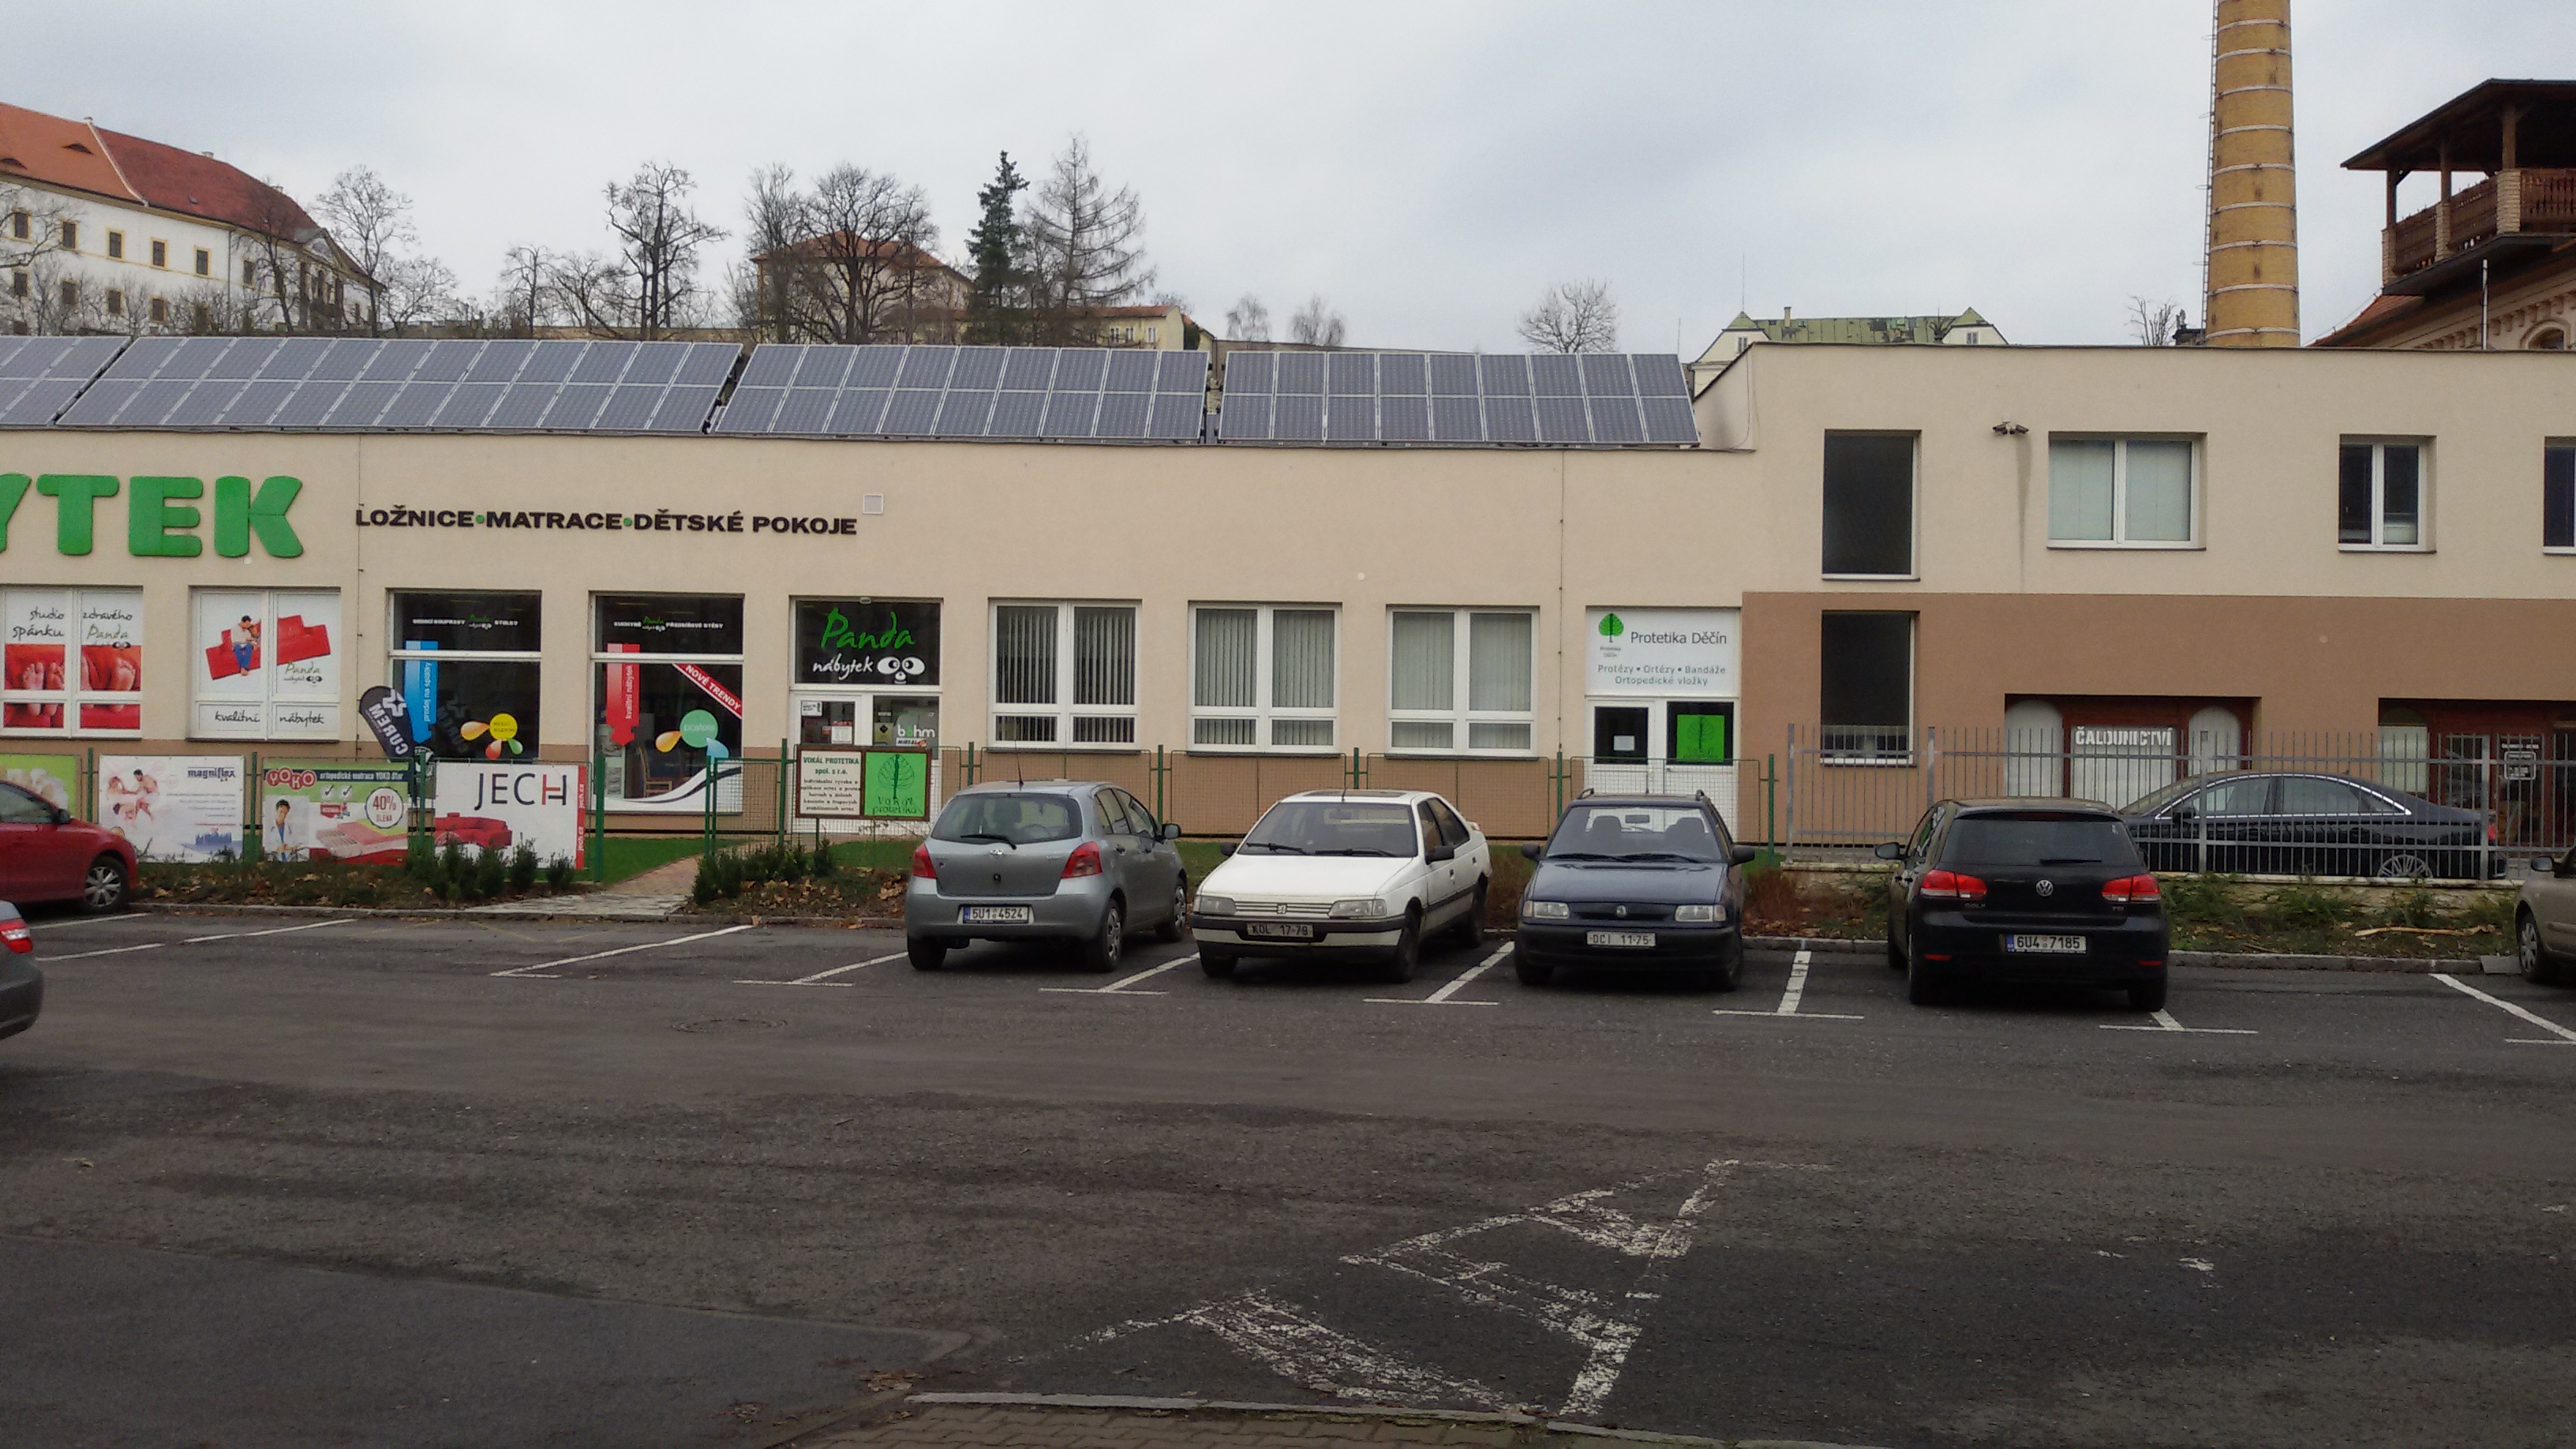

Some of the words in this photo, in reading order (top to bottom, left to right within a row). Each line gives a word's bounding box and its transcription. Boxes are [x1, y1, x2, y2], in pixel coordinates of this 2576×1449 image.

[356, 504, 474, 527] LOŽNICE
[486, 511, 622, 530] MATRACE
[634, 508, 743, 532] DĚTSKÉ
[752, 515, 857, 535] POKOJE
[30, 606, 65, 620] studio
[83, 607, 133, 621] zdravého
[13, 624, 64, 641] spánku
[821, 607, 915, 649] Panda
[1631, 631, 1687, 644] Protetika
[1691, 631, 1727, 644] Děčín
[812, 653, 874, 680] nábytek
[1598, 664, 1634, 674] Protézy
[1644, 665, 1675, 675] Ortézy
[1685, 665, 1726, 674] Bandáže
[685, 665, 710, 686] NOVÉ
[709, 683, 741, 711] TRENDY
[1616, 676, 1673, 685] Ortopedické
[1678, 676, 1708, 686] vložky
[215, 710, 260, 723] kvalitní
[279, 711, 324, 727] nábytek
[2075, 726, 2173, 746] ČALOUNICTVÍ
[803, 754, 823, 764] VOKÁL
[188, 767, 236, 779] magniflex
[268, 769, 315, 789] YOKO
[814, 767, 830, 776] spol.
[474, 773, 567, 811] JECH
[373, 796, 396, 811] 40%
[972, 908, 991, 919] 5U1
[998, 908, 1023, 919] 4524
[1252, 924, 1271, 934] KOL
[2016, 936, 2040, 948] 6U4
[2049, 936, 2080, 949] 7185
